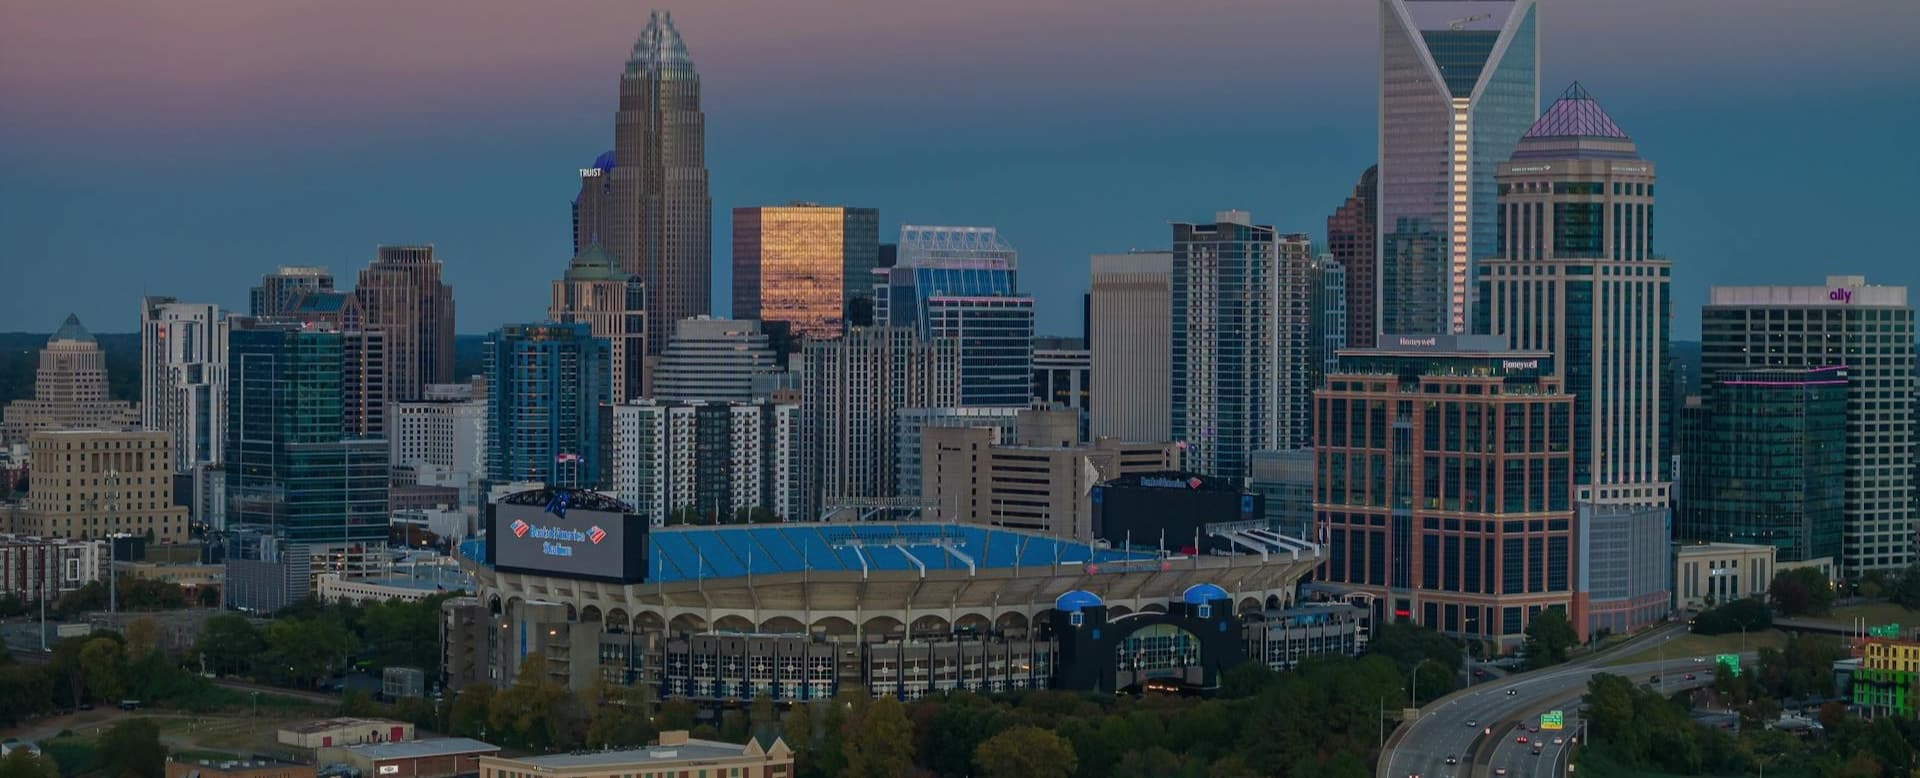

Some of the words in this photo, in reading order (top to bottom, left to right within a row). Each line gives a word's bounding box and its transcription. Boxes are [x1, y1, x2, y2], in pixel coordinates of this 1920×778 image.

[579, 168, 601, 177] TRUIST
[1830, 288, 1851, 304] ally
[1400, 337, 1435, 348] Honeywell
[1503, 360, 1538, 370] Honeywell
